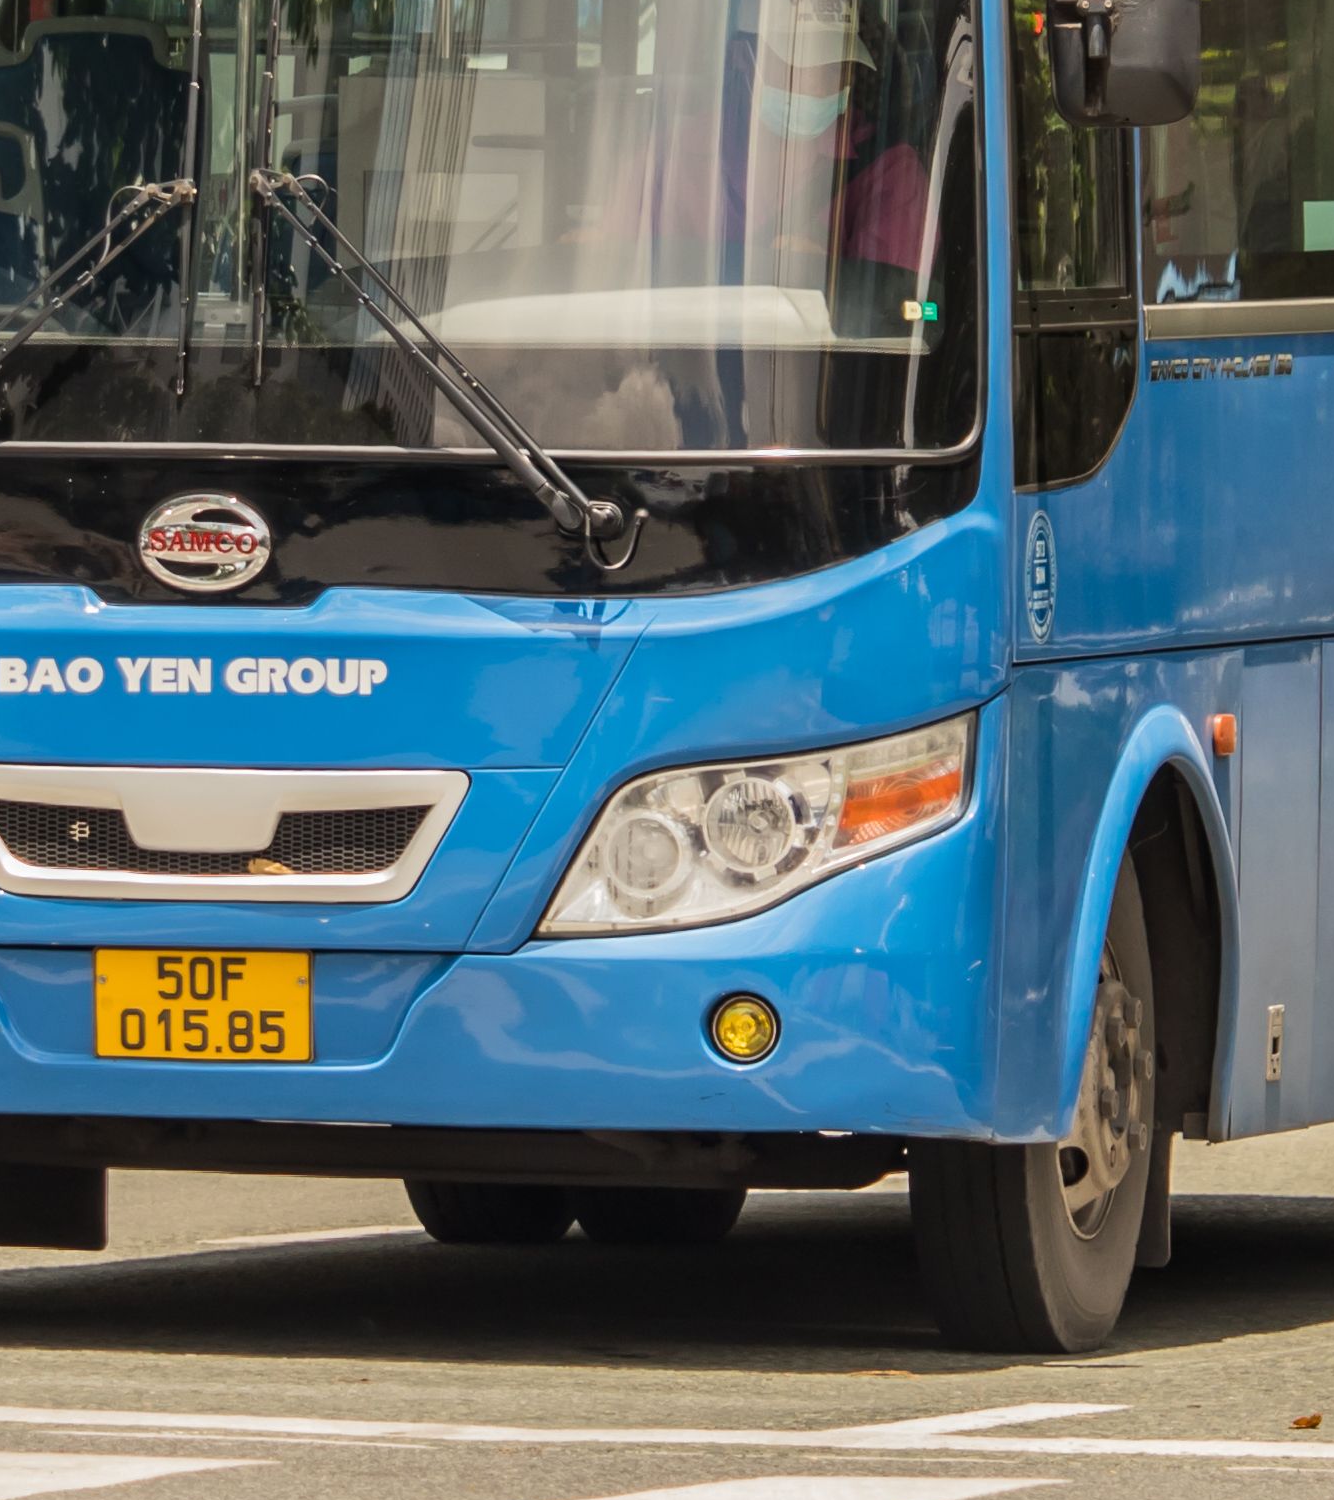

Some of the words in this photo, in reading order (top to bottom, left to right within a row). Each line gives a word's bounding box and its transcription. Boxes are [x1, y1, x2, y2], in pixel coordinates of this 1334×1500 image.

[148, 528, 259, 555] SAMCO
[117, 657, 212, 693] YEN
[225, 657, 388, 695] GROUP
[157, 956, 247, 1001] 50F
[120, 1008, 285, 1054] 015.85
